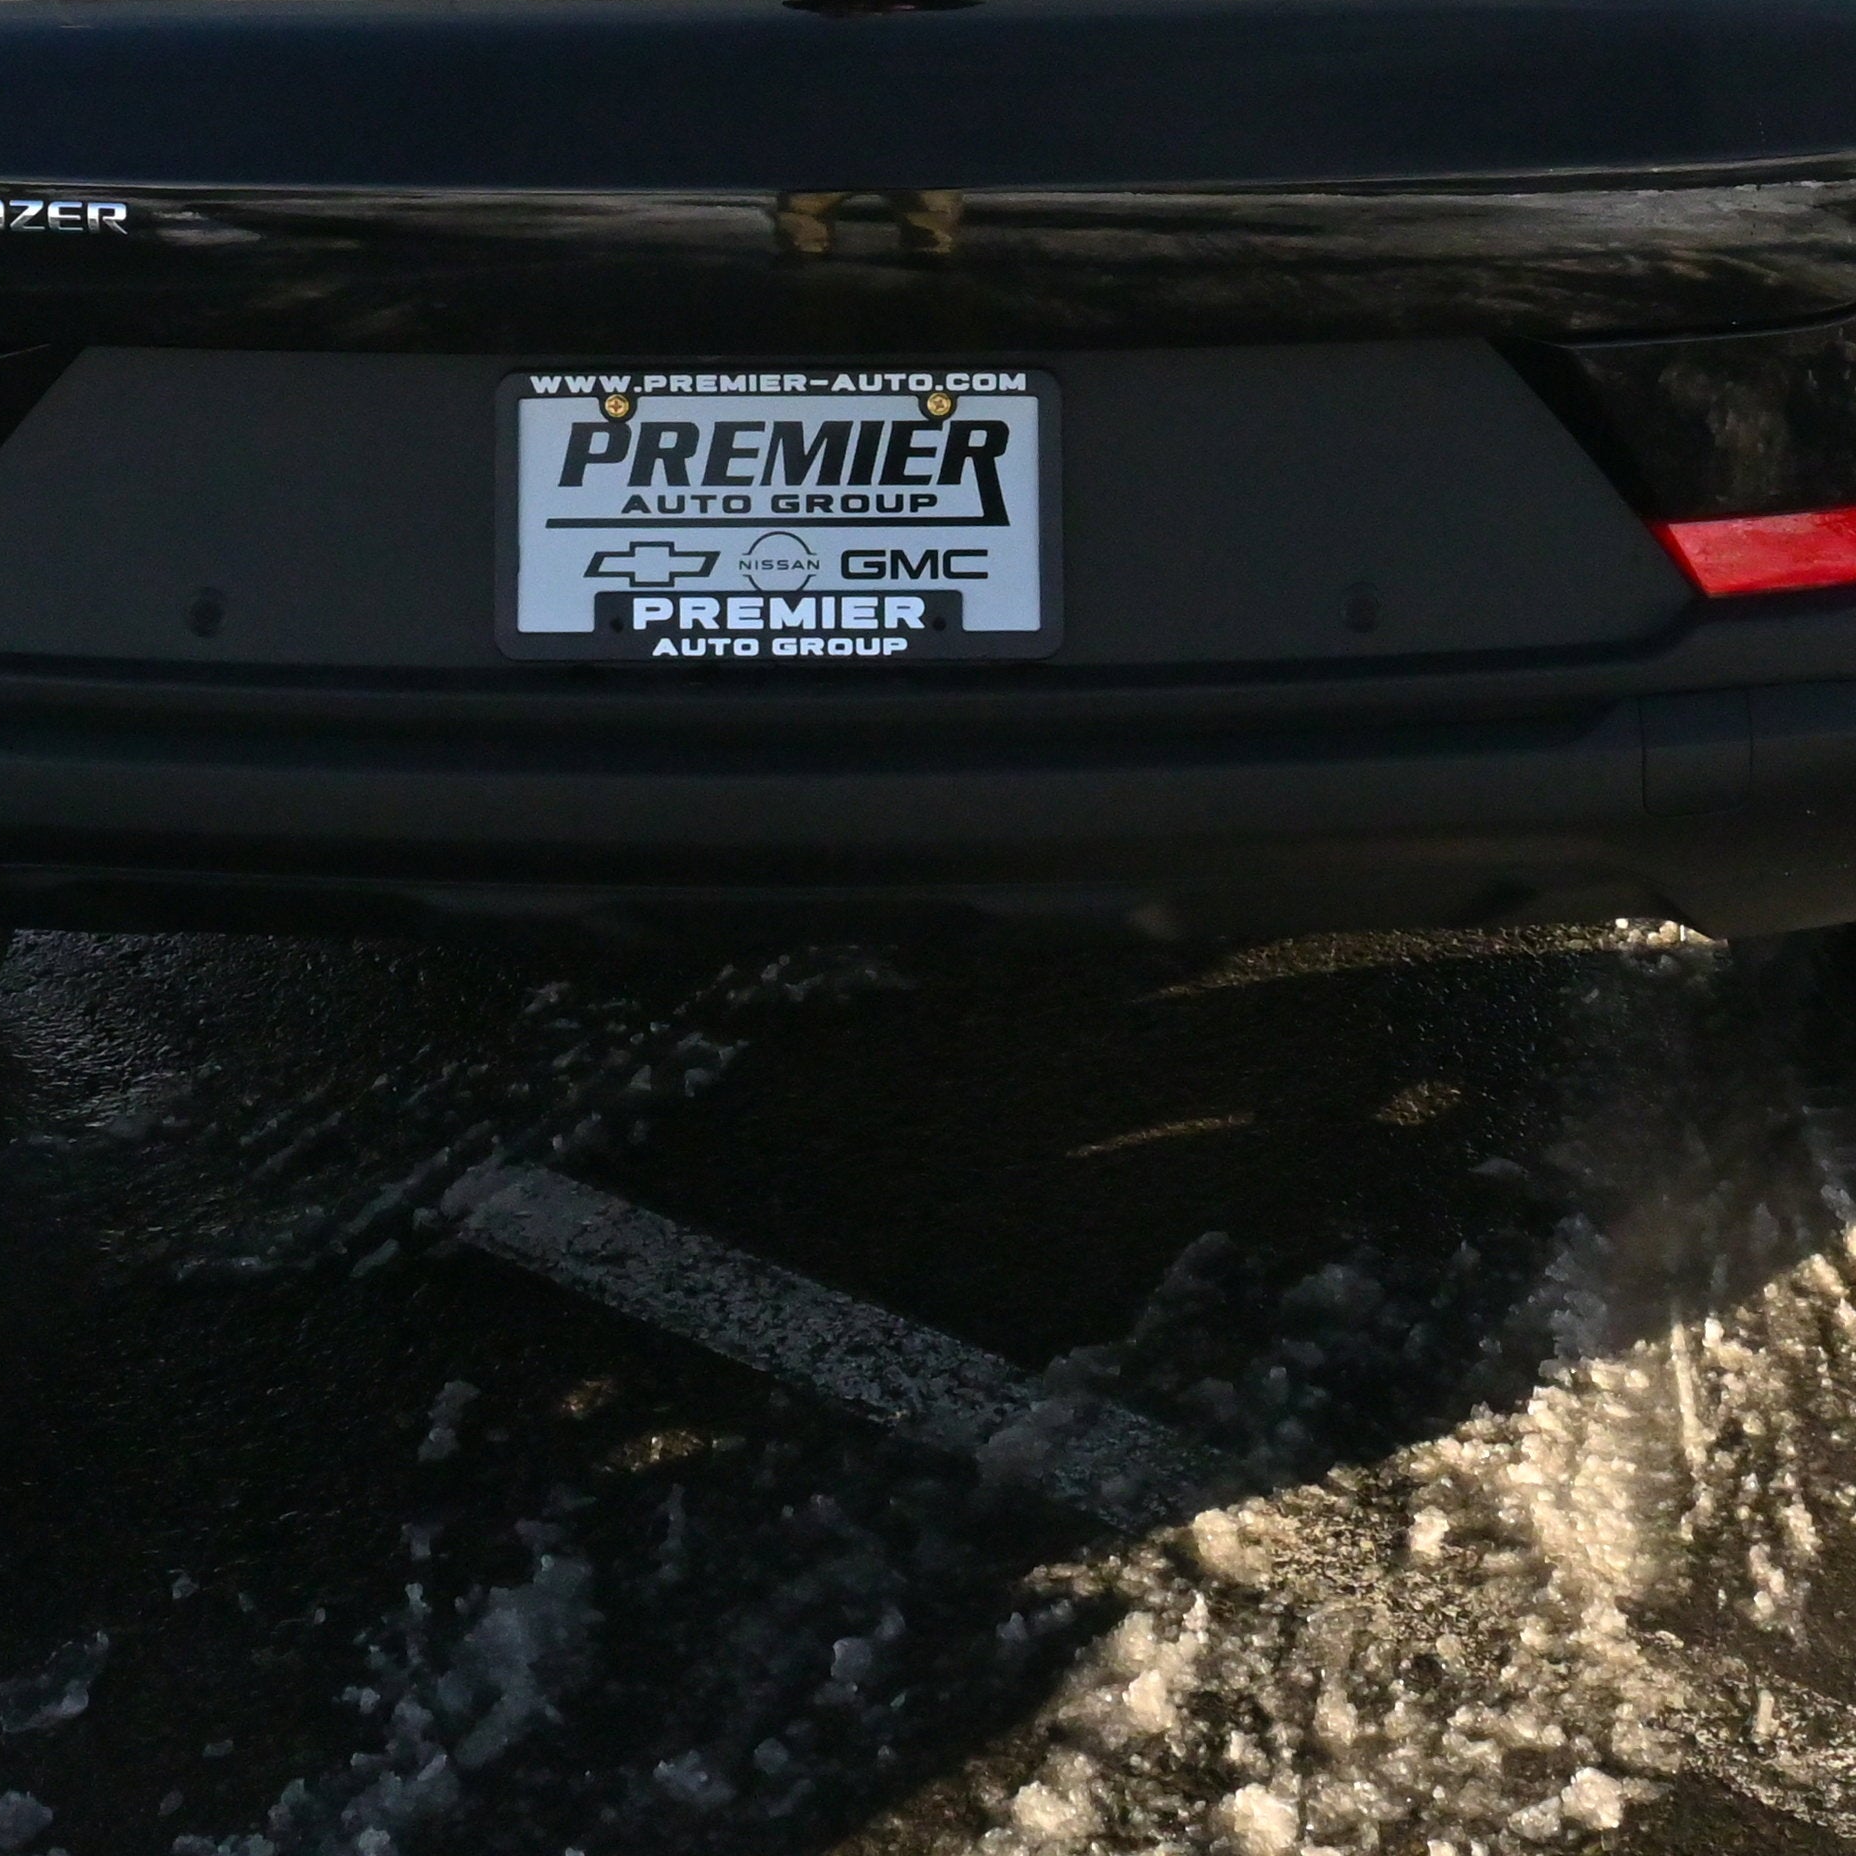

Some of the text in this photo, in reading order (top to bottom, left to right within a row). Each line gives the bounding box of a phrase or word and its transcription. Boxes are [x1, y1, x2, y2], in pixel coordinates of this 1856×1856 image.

[529, 372, 1028, 395] WWW.PREMIER-AUTO.COM
[557, 419, 1011, 506] PREMIER
[620, 493, 939, 514] AUTO GROUP
[738, 558, 821, 571] NISSAN
[840, 548, 989, 581] GMC
[632, 595, 926, 631] PREMIER
[652, 636, 909, 657] AUTO GROUP
